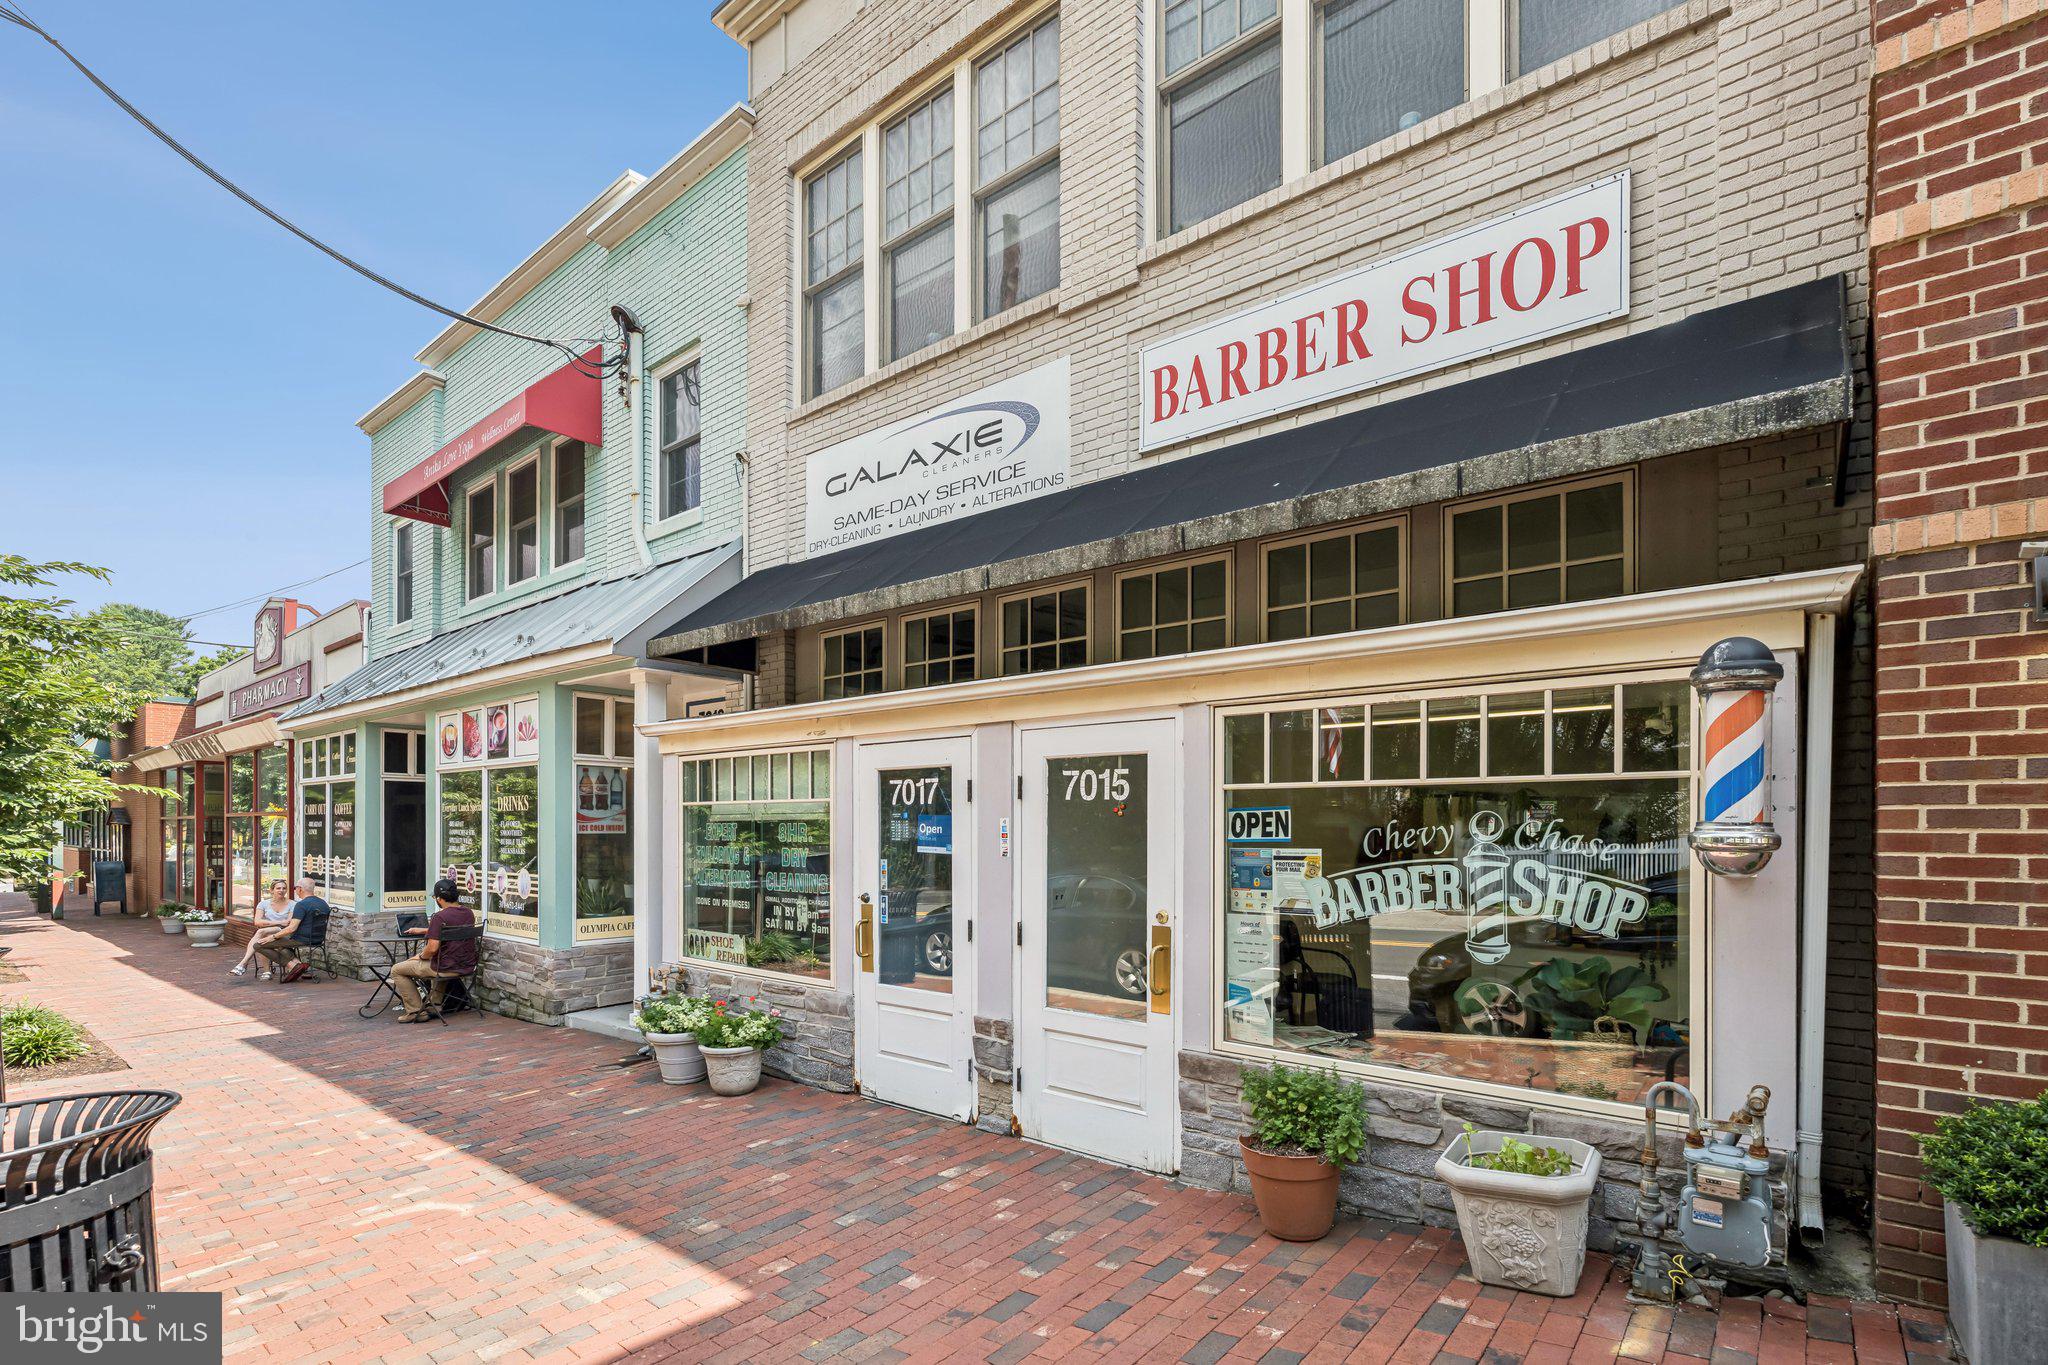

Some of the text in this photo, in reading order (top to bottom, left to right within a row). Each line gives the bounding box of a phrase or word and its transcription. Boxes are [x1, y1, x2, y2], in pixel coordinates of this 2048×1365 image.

[1151, 216, 1610, 424] BARBER SHOP
[825, 418, 1003, 497] GALAXIE
[922, 447, 1003, 478] CLEANERS
[834, 461, 1027, 531] SAME-DAY SERVICE
[809, 472, 1065, 553] DRY-CLEANING LAUNDRY ALTERATIONS
[242, 677, 289, 708] PHARMACY
[889, 778, 939, 805] 7017
[1062, 768, 1130, 801] 7015
[334, 802, 353, 815] COFFEE
[497, 795, 529, 811] DRINKS
[606, 824, 624, 832] INSIDE
[705, 822, 738, 841] EXPERT
[920, 823, 942, 835] Open
[1231, 810, 1289, 839] OPEN
[1363, 818, 1621, 861] Chevy Chase
[781, 847, 809, 868] DRY
[696, 869, 751, 889] ALTERATIONS
[387, 894, 417, 903] OLYMPIA
[712, 898, 721, 907] ON
[1302, 859, 1650, 940] BARBER SHOP
[773, 905, 782, 916] IN
[785, 906, 796, 917] BY
[580, 923, 615, 934] OLYMPIA
[765, 918, 829, 934] SAT. IN BY 9am
[711, 935, 734, 949] SHOE
[716, 949, 745, 965] REPAIR
